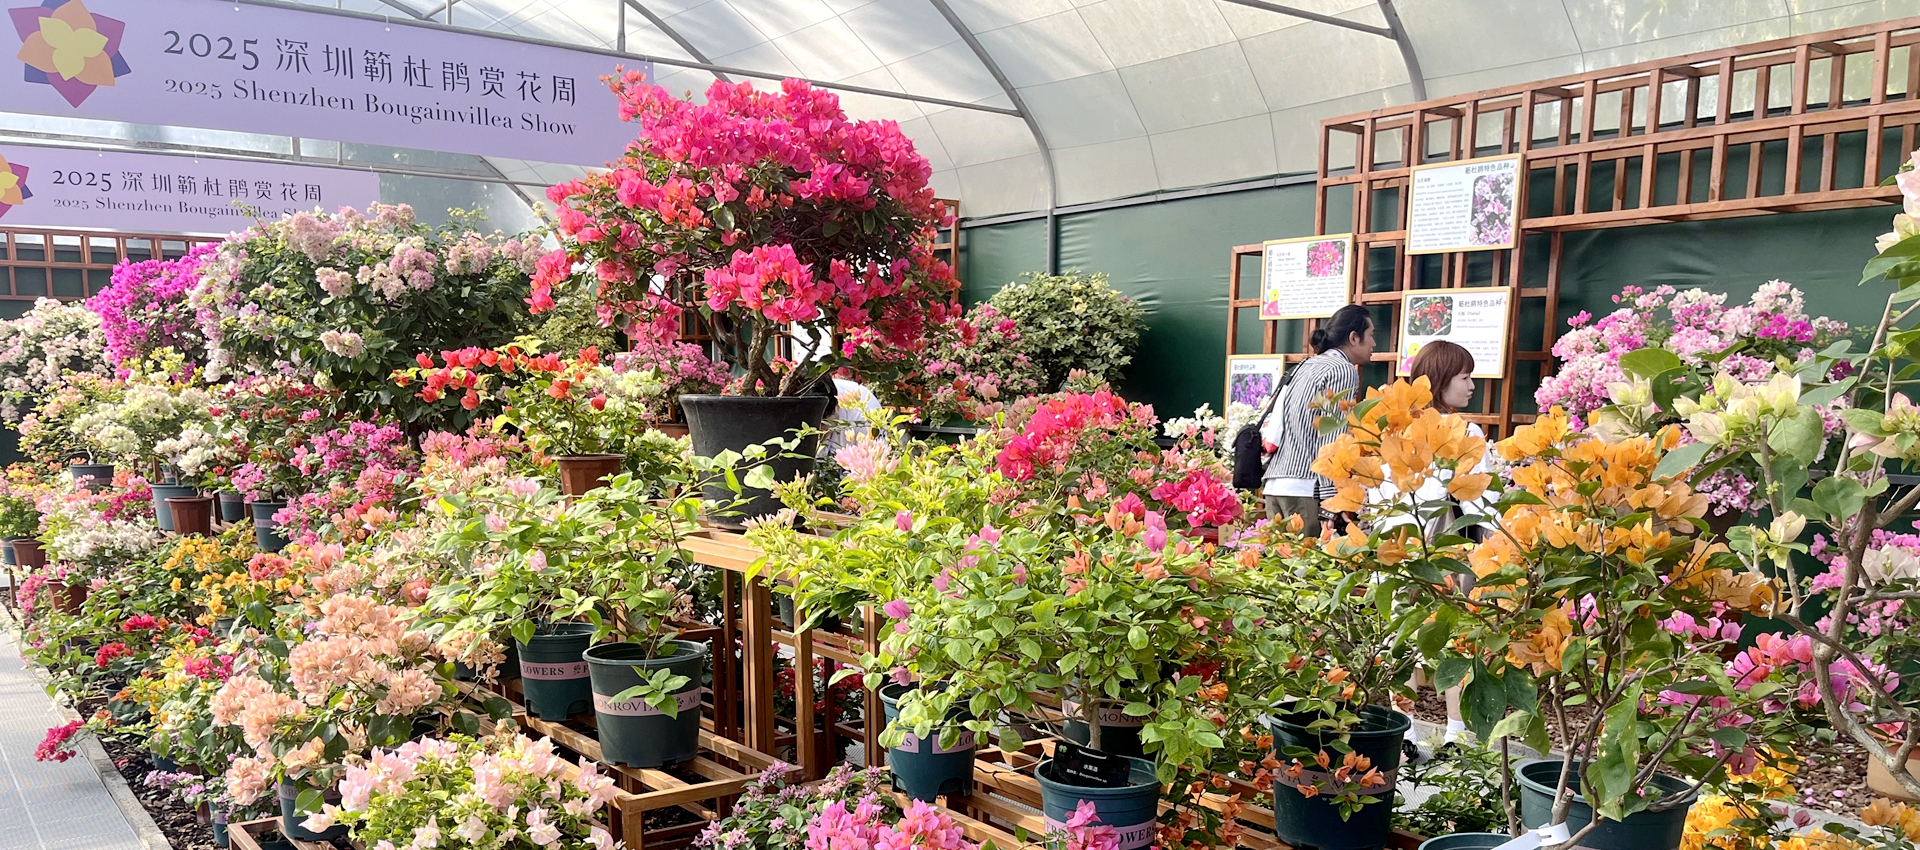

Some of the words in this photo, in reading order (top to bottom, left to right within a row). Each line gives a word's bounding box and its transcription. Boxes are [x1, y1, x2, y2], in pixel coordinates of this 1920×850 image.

[163, 30, 259, 71] 2025
[275, 38, 576, 107] 深圳簕杜鹃赏花周
[164, 79, 223, 100] 2025
[233, 79, 355, 111] Shenzhen
[364, 93, 513, 129] Bougainvillea
[520, 112, 577, 136] Show
[52, 170, 112, 192] 2025
[121, 171, 321, 203] 深圳簕杜鹃赏花周
[53, 198, 89, 210] 2025
[95, 197, 166, 212] Shenzhen
[179, 201, 278, 219] Bougainllea
[523, 665, 564, 676] LOWERS
[596, 699, 659, 711] ONROVI
